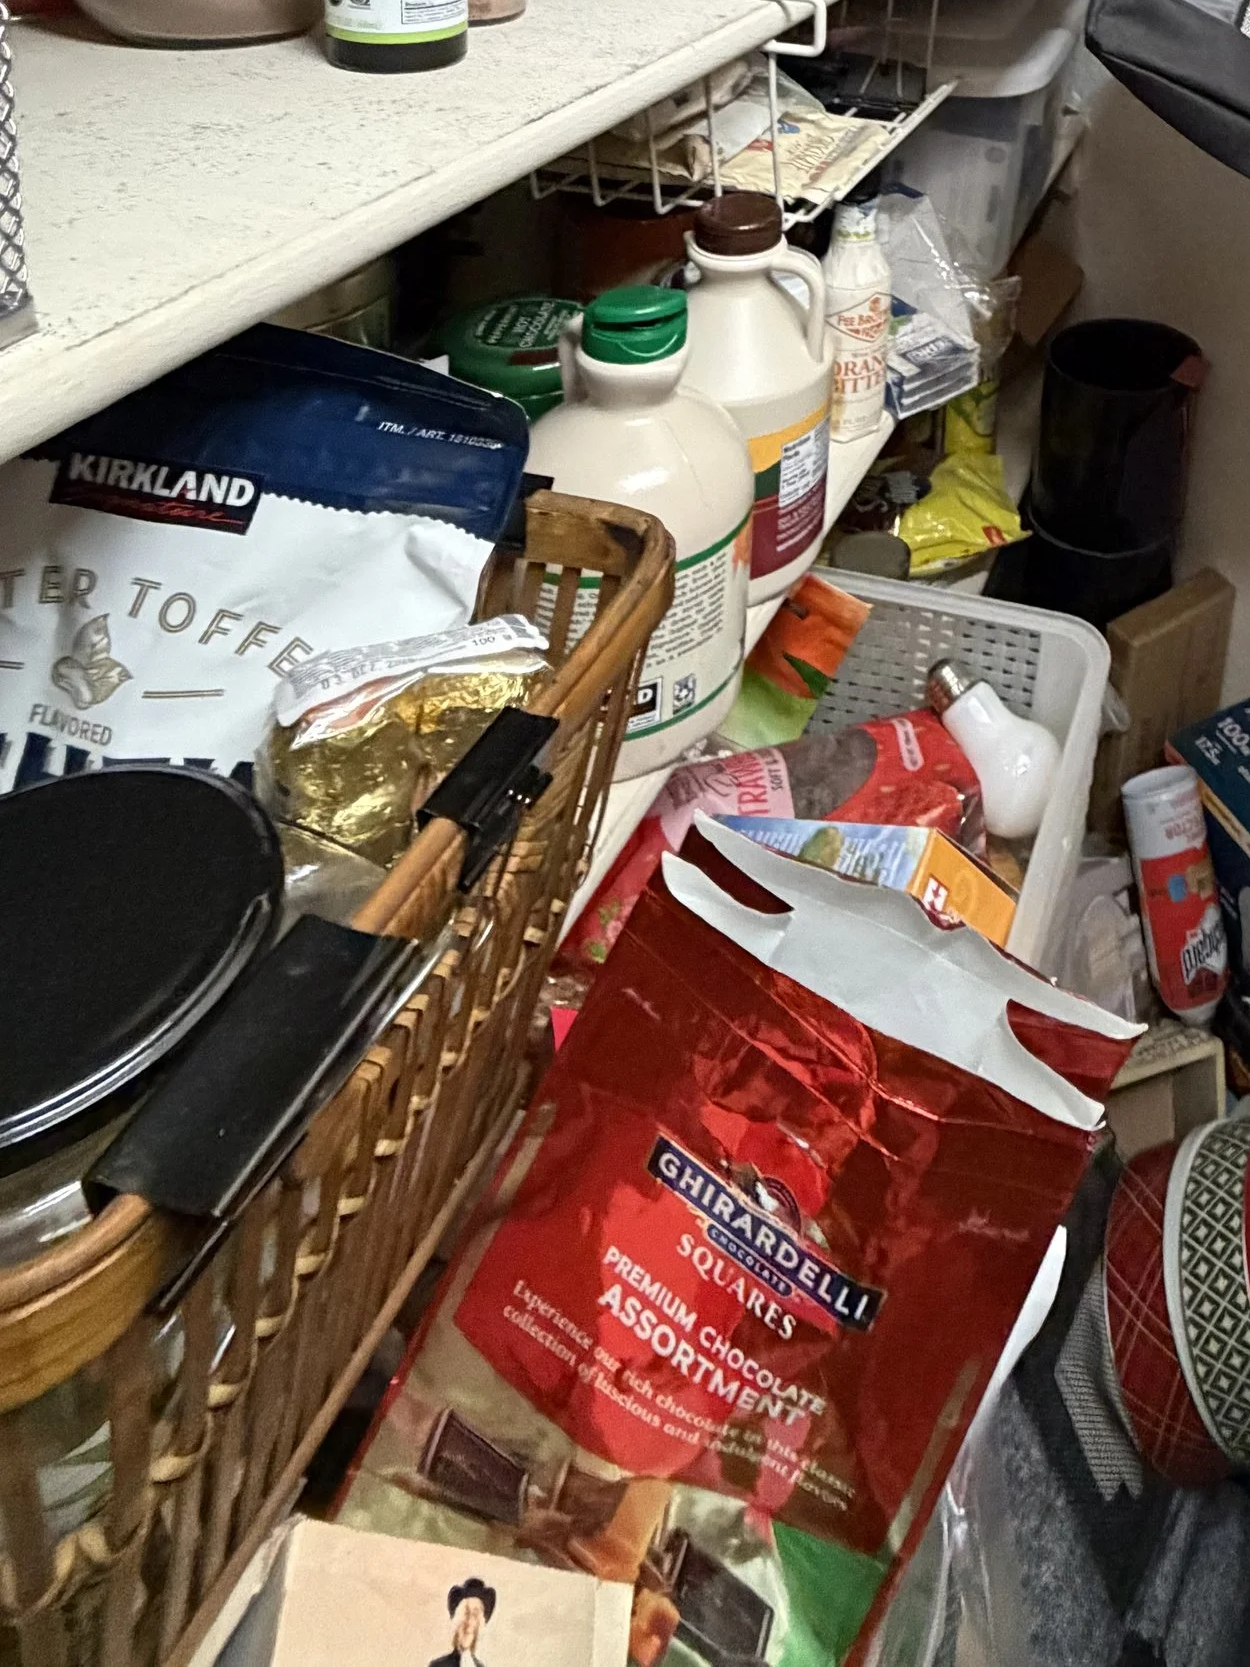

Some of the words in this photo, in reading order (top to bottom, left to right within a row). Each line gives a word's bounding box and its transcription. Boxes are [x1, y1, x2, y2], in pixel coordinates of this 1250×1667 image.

[69, 451, 255, 507] KIRKLAND
[377, 421, 405, 436] ITM.
[127, 576, 318, 680] TOFFE
[472, 634, 496, 648] 100
[28, 702, 113, 747] FLAVORED
[658, 1151, 870, 1322] GHIRARDELLI
[676, 1232, 798, 1341] SQUARES
[709, 1226, 791, 1296] CHOCOLATE
[502, 1304, 578, 1368] collection
[593, 1371, 663, 1428] luscious
[662, 1421, 702, 1446] and
[511, 1278, 595, 1352] Experience
[621, 1369, 654, 1400] rich
[655, 1393, 741, 1438] chocolate
[597, 1283, 807, 1427] ASSORTMENT
[601, 1245, 699, 1334] PREMIUM
[698, 1325, 827, 1417] CHOCOLATE
